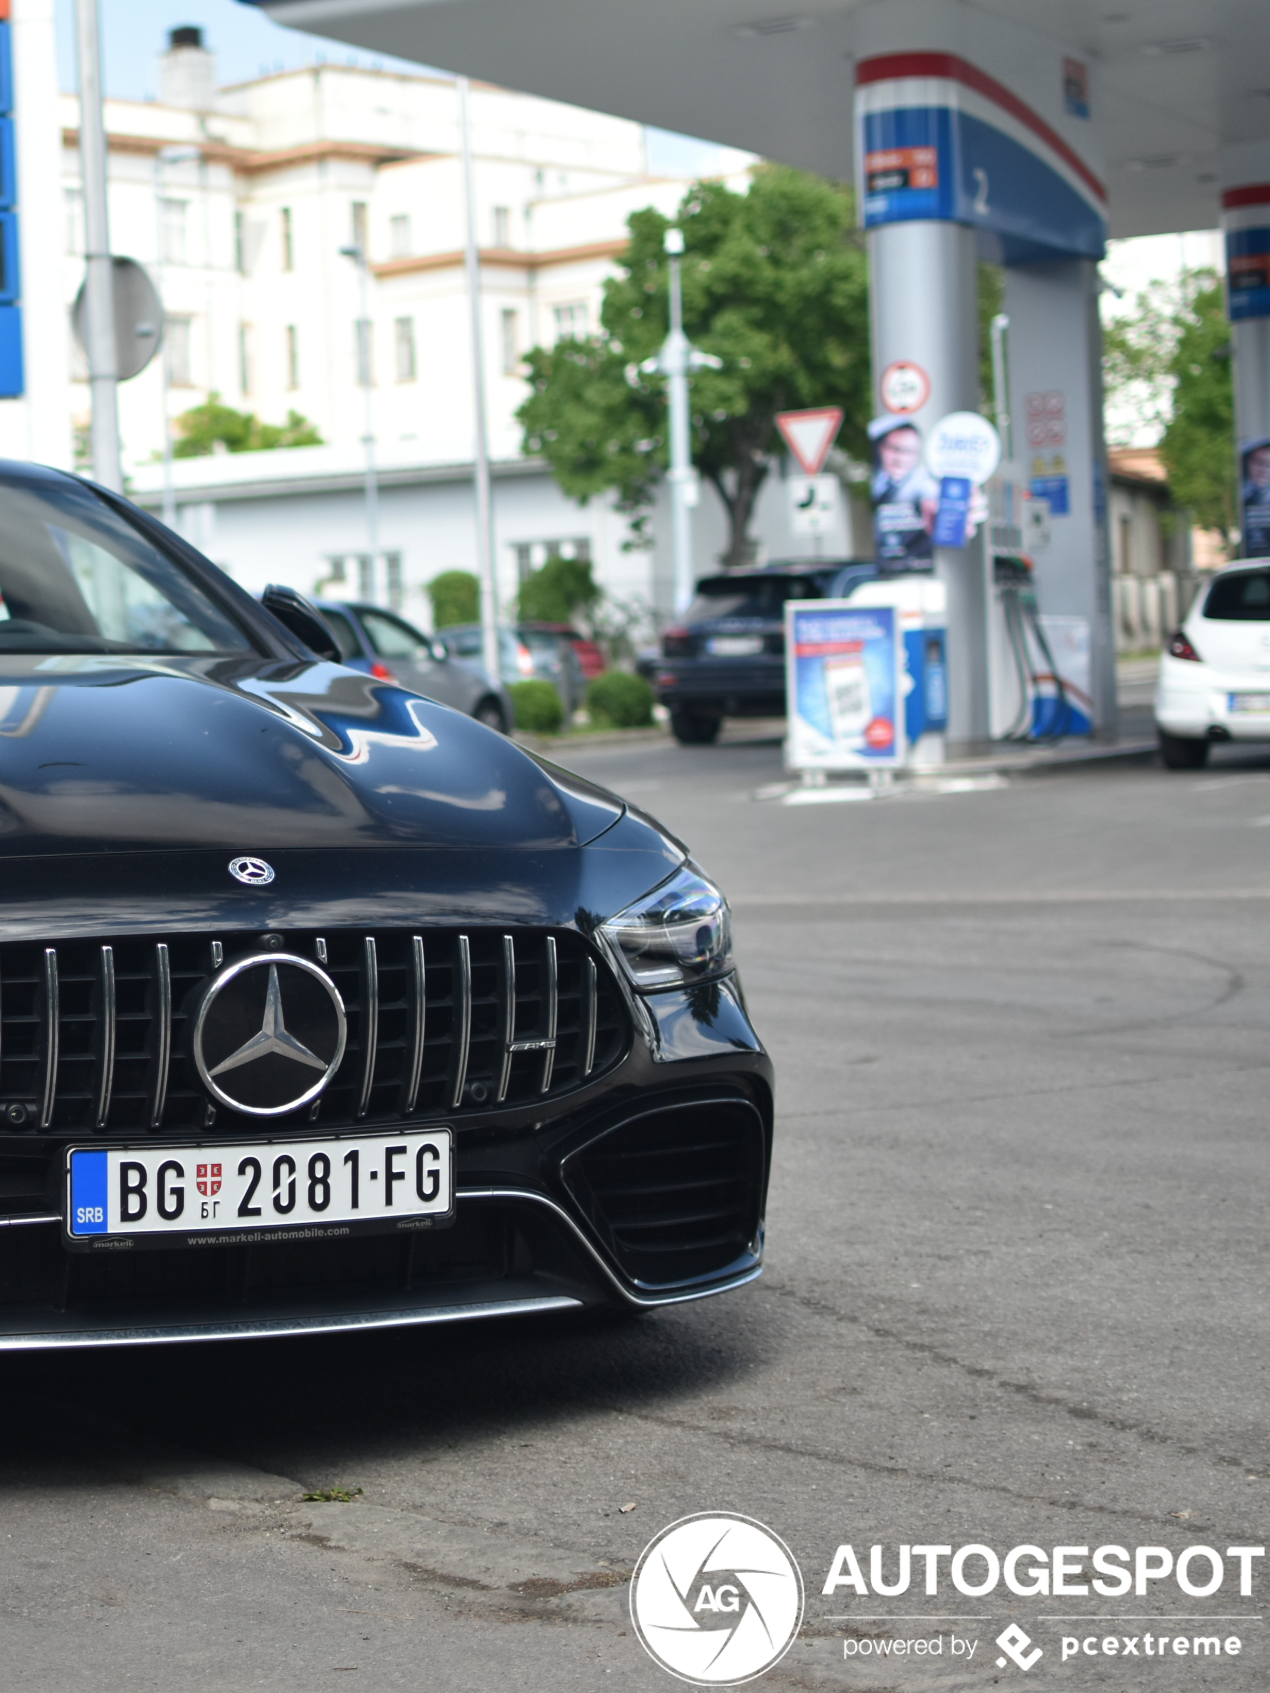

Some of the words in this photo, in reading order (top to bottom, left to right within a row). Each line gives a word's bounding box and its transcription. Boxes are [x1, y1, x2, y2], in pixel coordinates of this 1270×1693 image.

[523, 1041, 556, 1050] AMG
[119, 1160, 185, 1222] BG
[76, 1207, 104, 1223] SRB
[200, 1200, 220, 1219] БГ
[188, 1227, 350, 1246] www.markeli-automobile.com
